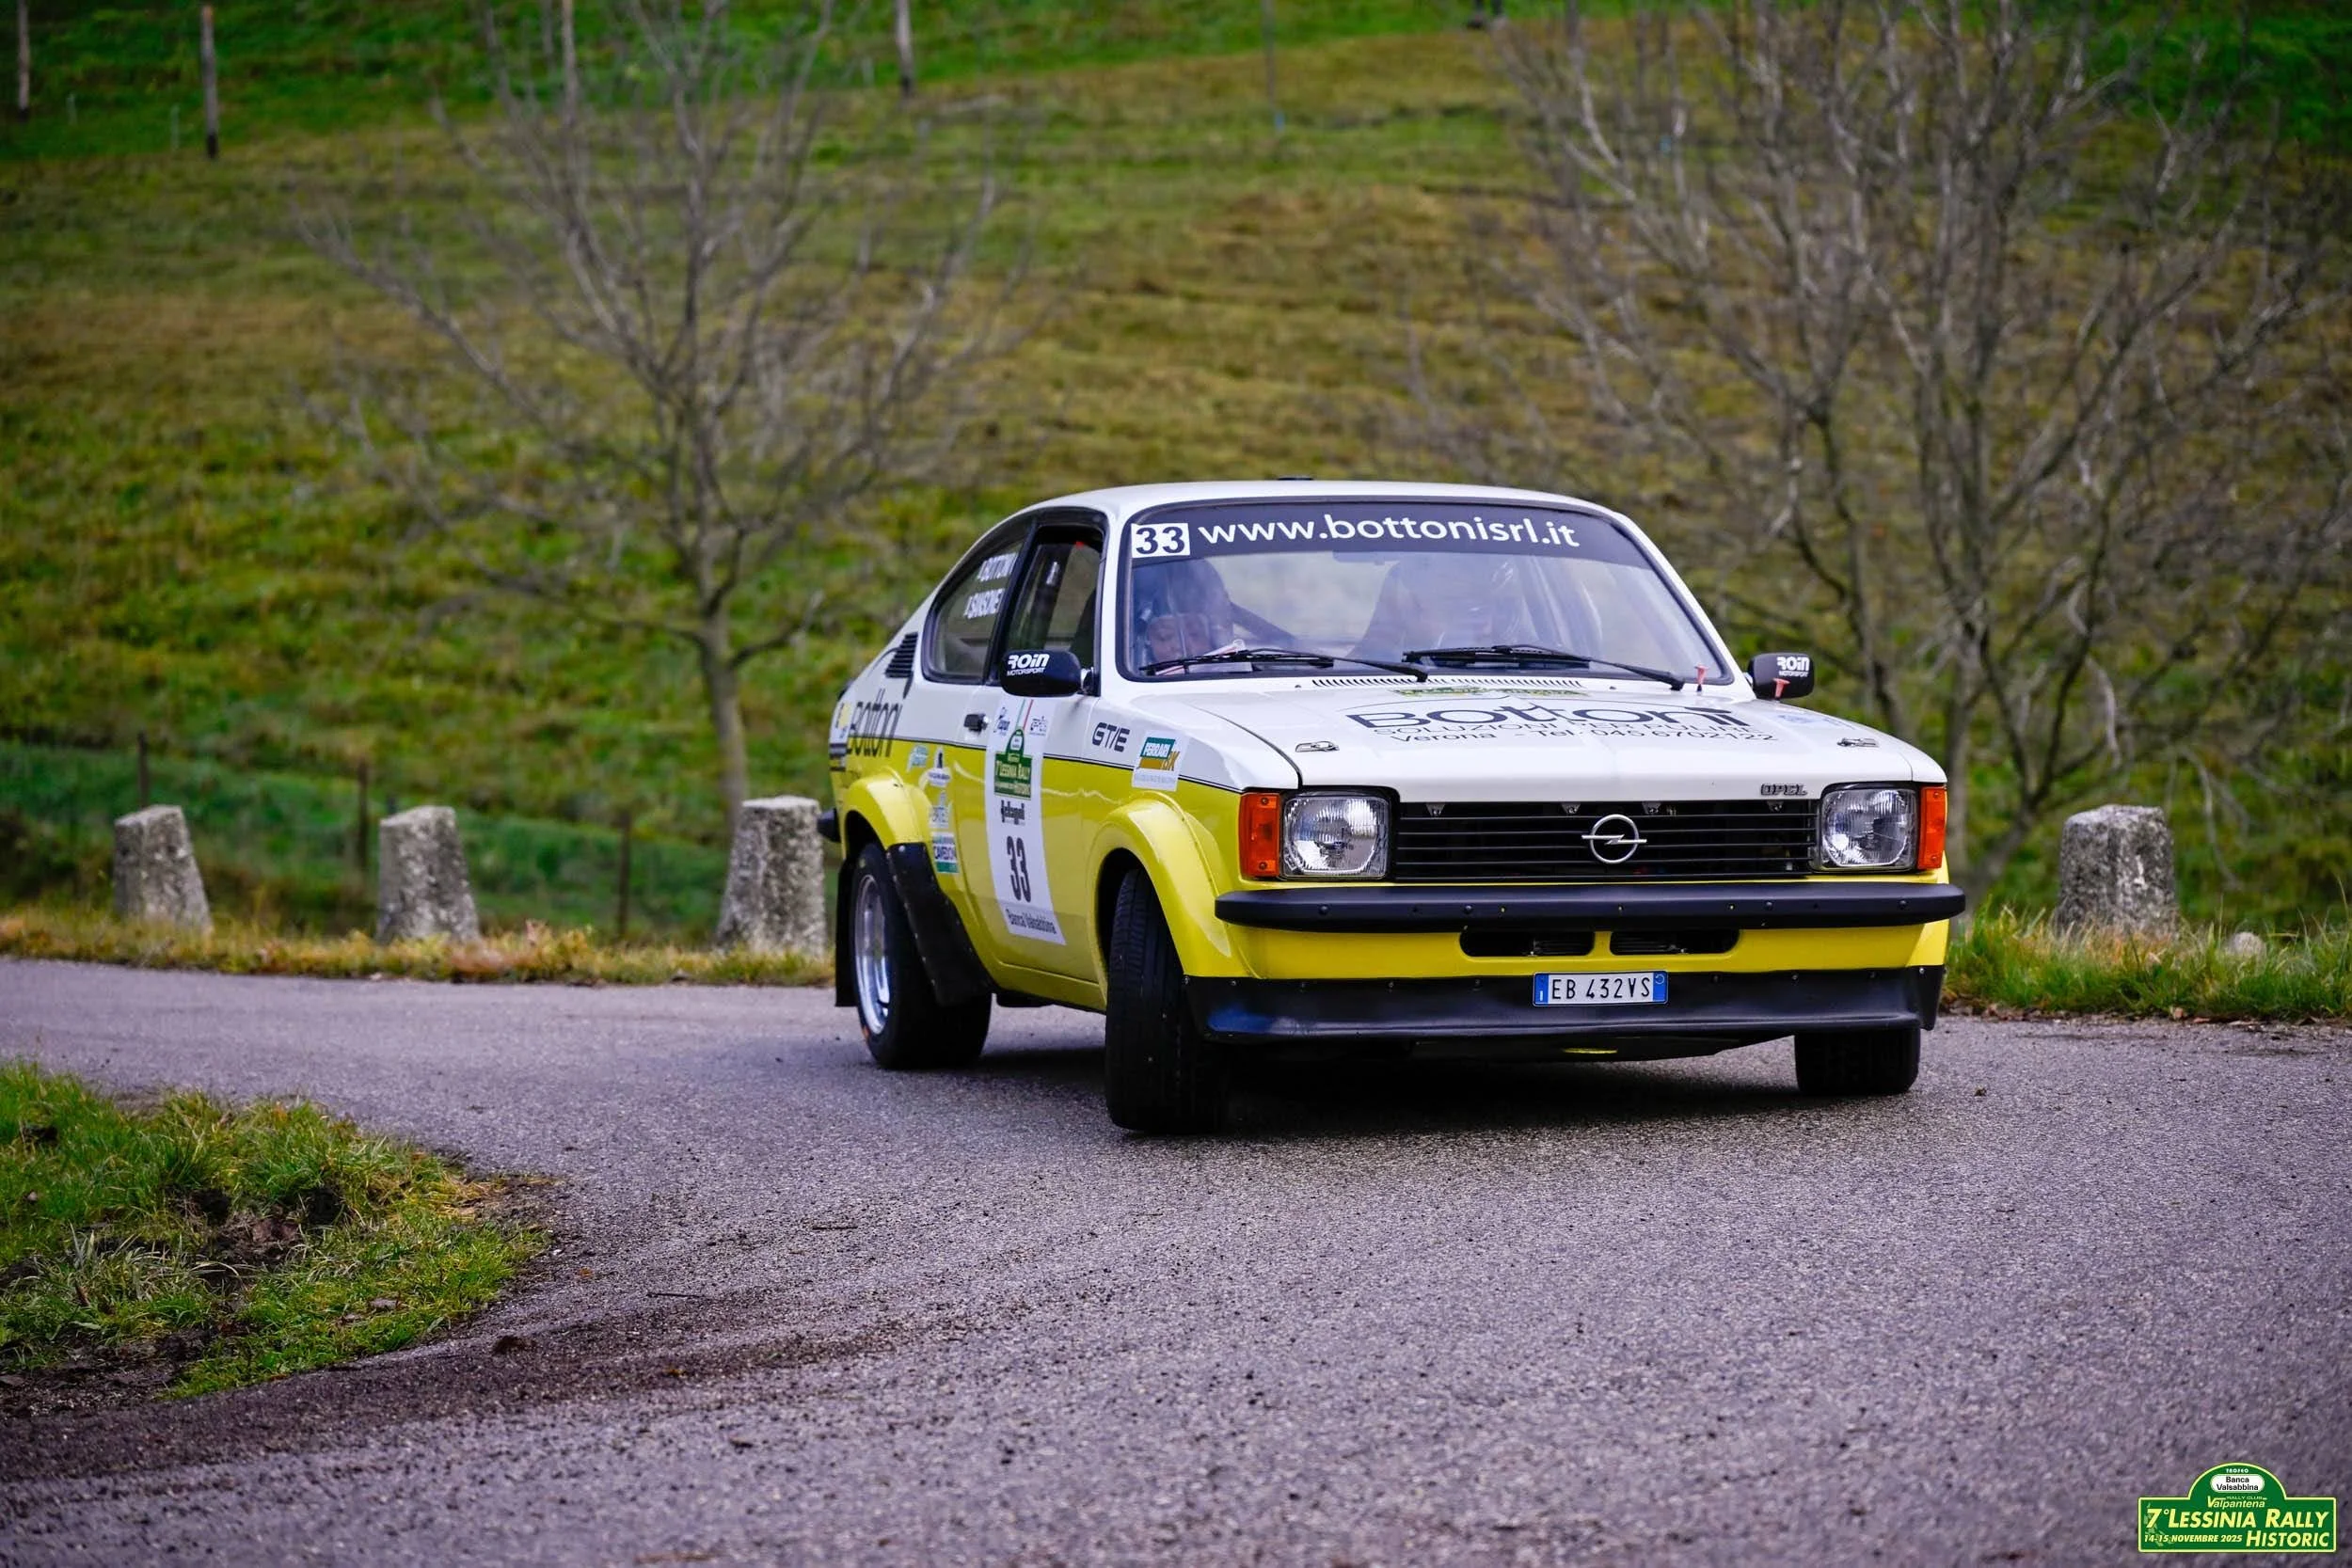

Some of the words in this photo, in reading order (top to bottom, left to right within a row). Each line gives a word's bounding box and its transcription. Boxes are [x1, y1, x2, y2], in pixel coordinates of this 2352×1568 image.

[1197, 514, 1581, 548] www.bottonisrl.it
[1135, 525, 1186, 556] 33
[1007, 667, 1046, 676] MOTORSPORT
[1374, 722, 1558, 736] SOLUZIONI
[1643, 724, 1767, 735] PULIRE
[1390, 733, 1497, 742] Verona
[1590, 729, 1646, 737] 045
[1651, 731, 1778, 741] 6702122
[1760, 783, 1808, 797] OPEL
[1006, 835, 1032, 903] 33
[1551, 978, 1577, 1000] EB
